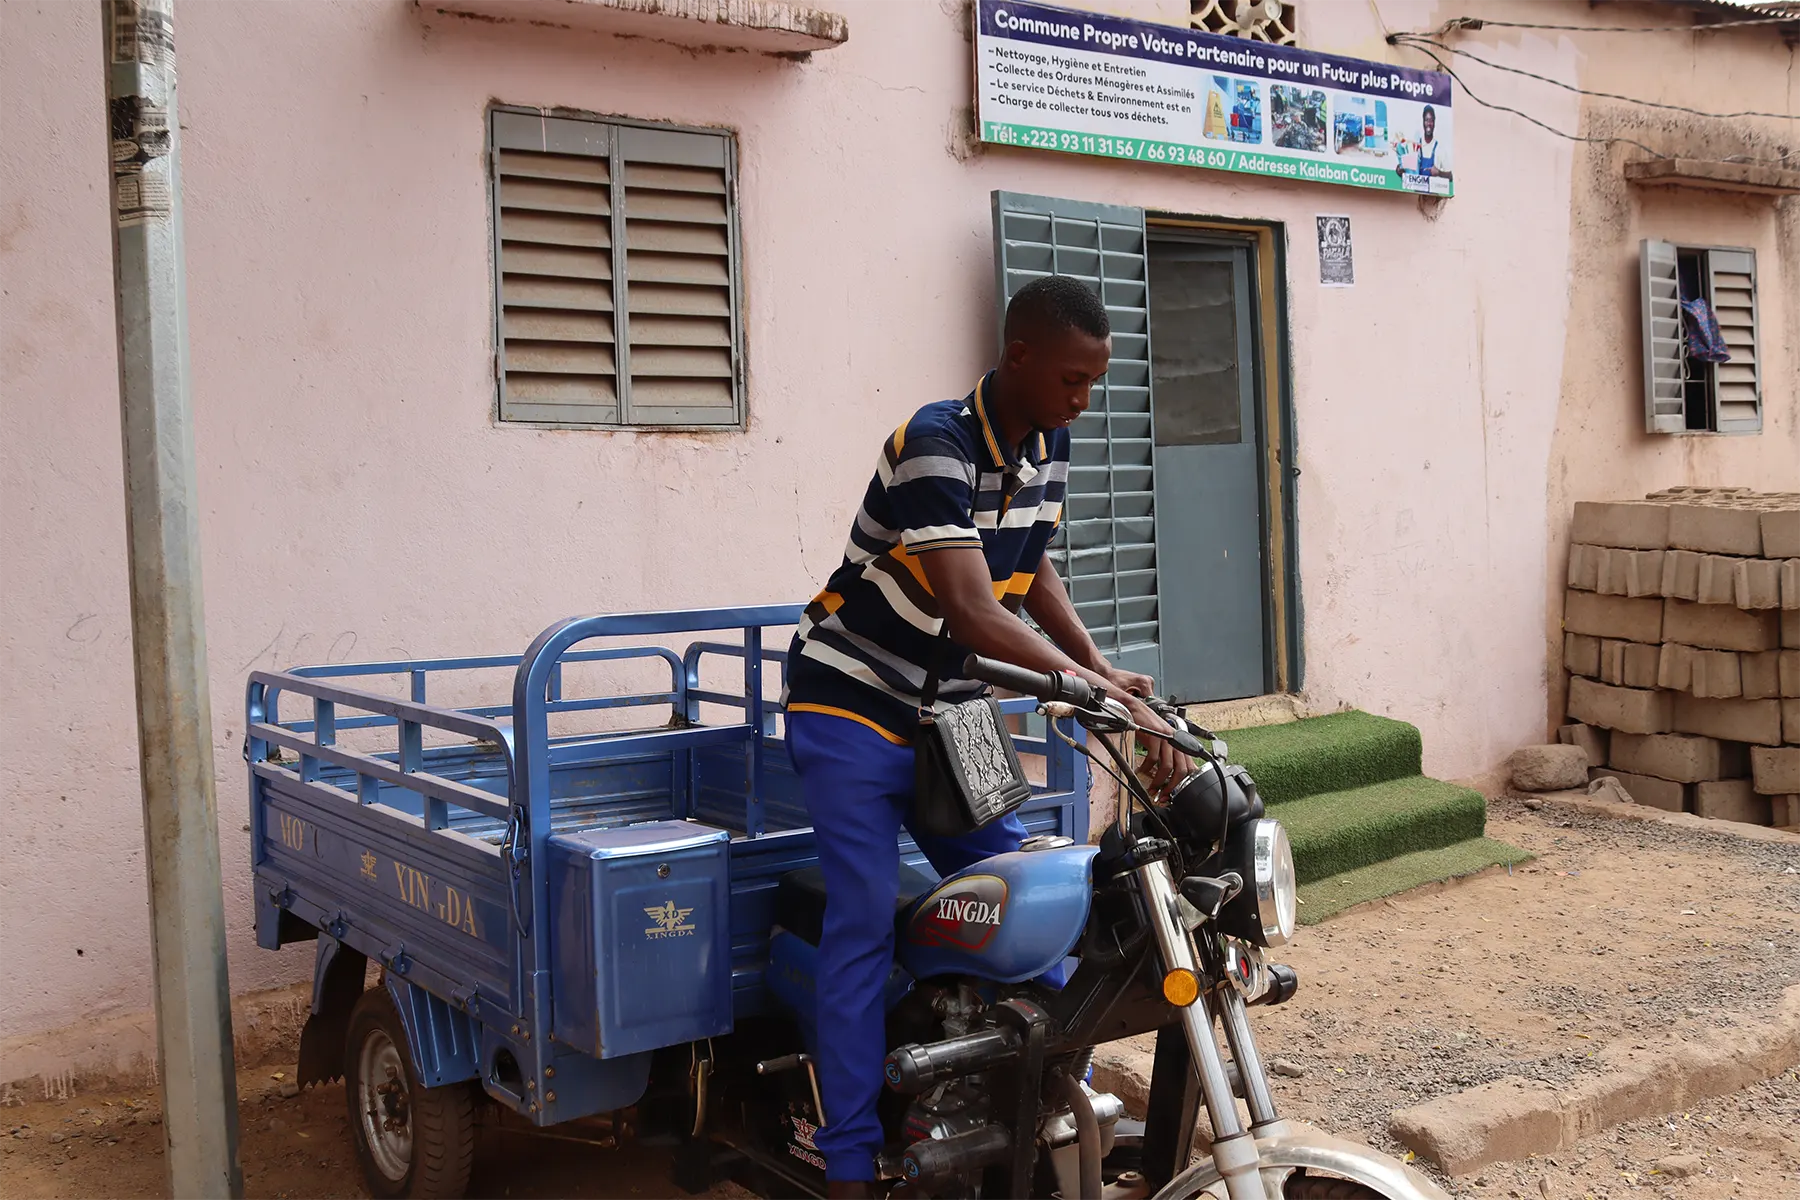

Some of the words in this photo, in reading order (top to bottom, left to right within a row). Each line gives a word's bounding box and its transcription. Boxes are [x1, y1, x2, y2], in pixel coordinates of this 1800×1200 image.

[994, 9, 1080, 40] Commune
[1083, 23, 1138, 50] Propre
[1140, 32, 1184, 56] Votre
[1187, 40, 1265, 69] Partenaire
[1267, 57, 1300, 74] pour
[1302, 63, 1319, 78] un
[1321, 62, 1359, 84] Futur
[1361, 70, 1388, 89] plus
[1390, 74, 1433, 97] Propre
[1052, 55, 1090, 70] Hygiène
[1091, 62, 1102, 71] et
[1104, 62, 1146, 77] Entretien
[1011, 82, 1045, 94] service
[1047, 85, 1086, 100] Déchets
[1087, 90, 1095, 101] &
[1097, 92, 1164, 110] Environnement
[1166, 102, 1180, 112] est
[1181, 105, 1191, 113] en
[1037, 69, 1053, 80] des
[1055, 71, 1092, 85] Ordures
[1094, 76, 1144, 92] Ménagères
[1145, 85, 1155, 94] et
[1156, 85, 1195, 99] Assimilés
[1035, 100, 1047, 109] de
[1049, 101, 1089, 115] collecter
[1090, 107, 1111, 118] tous
[1113, 111, 1129, 120] vos
[1131, 111, 1169, 125] déchets.
[990, 124, 1017, 144] Tél:
[1021, 129, 1058, 148] +223
[1060, 133, 1079, 150] 93
[1082, 136, 1095, 153] 11
[1098, 137, 1113, 154] 31
[1116, 139, 1134, 157] 56
[1136, 141, 1146, 159] /
[1147, 143, 1166, 160] 66
[1168, 145, 1185, 163] 93
[1187, 148, 1205, 165] 48
[1207, 151, 1226, 167] 60
[1228, 152, 1236, 169] /
[1238, 154, 1297, 175] Addresse
[1299, 161, 1349, 181] Kalaban
[1350, 168, 1386, 185] Coura
[936, 898, 1001, 926] XINGDA
